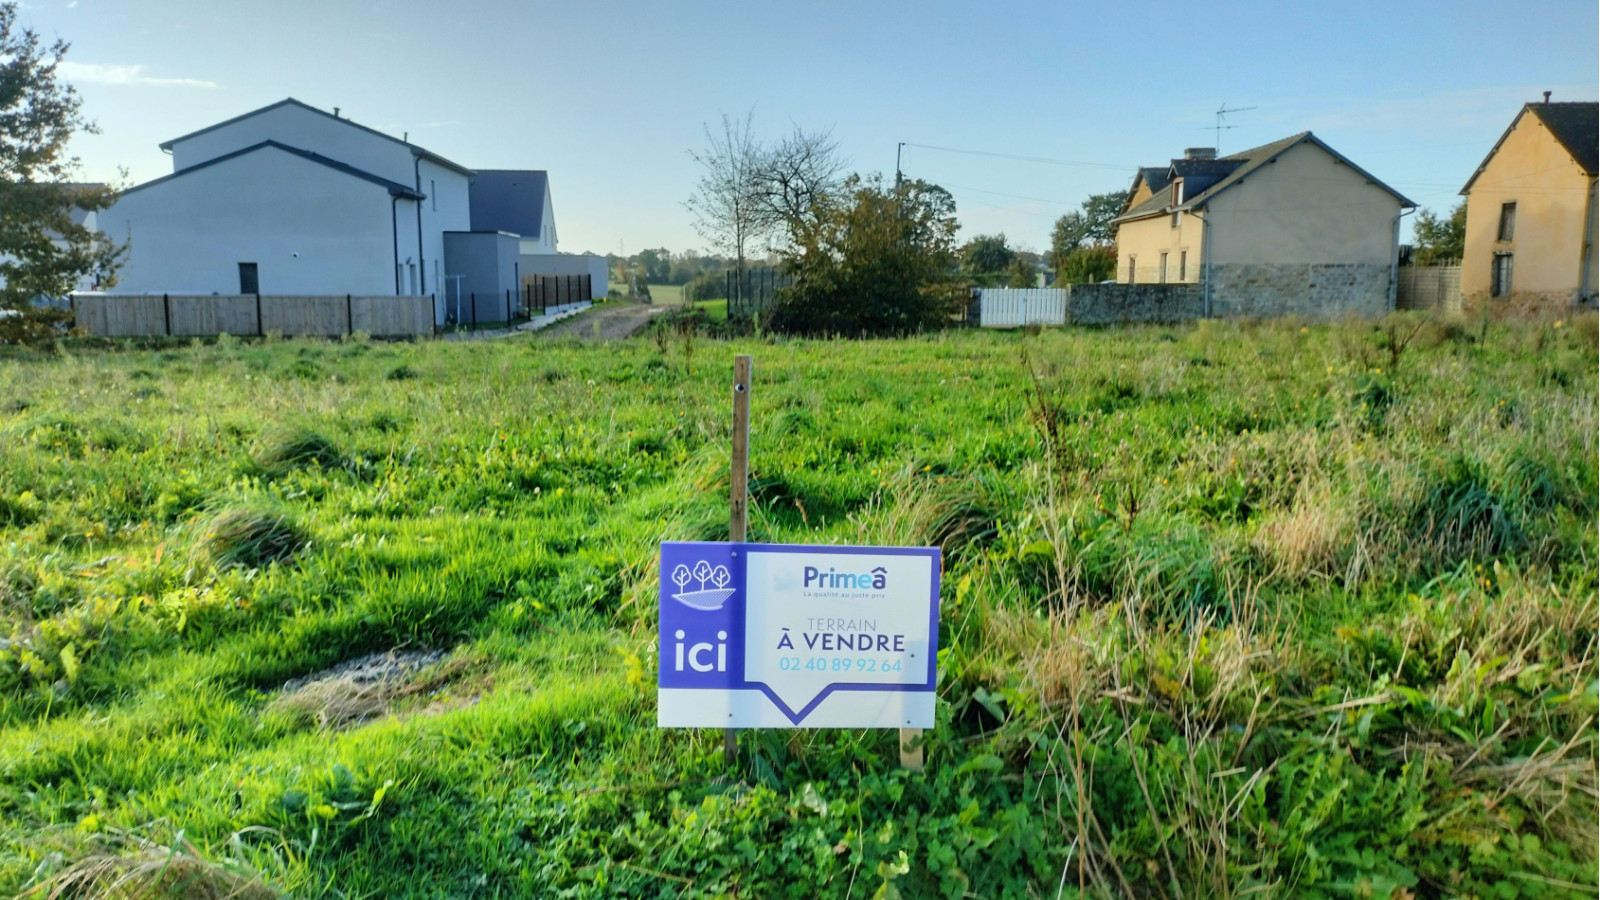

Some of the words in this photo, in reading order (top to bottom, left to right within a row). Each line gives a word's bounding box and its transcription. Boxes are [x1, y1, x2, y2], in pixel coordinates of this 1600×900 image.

[814, 591, 839, 599] qualité
[851, 591, 870, 599] juste
[872, 592, 885, 600] prix
[808, 618, 876, 632] TERRAIN
[777, 627, 795, 650] À
[803, 632, 905, 652] VENDRE
[675, 629, 727, 672] ici
[779, 656, 800, 671] 02
[805, 657, 827, 671] 40
[832, 657, 852, 672] 89
[856, 658, 877, 672] 92
[881, 658, 902, 673] 64
